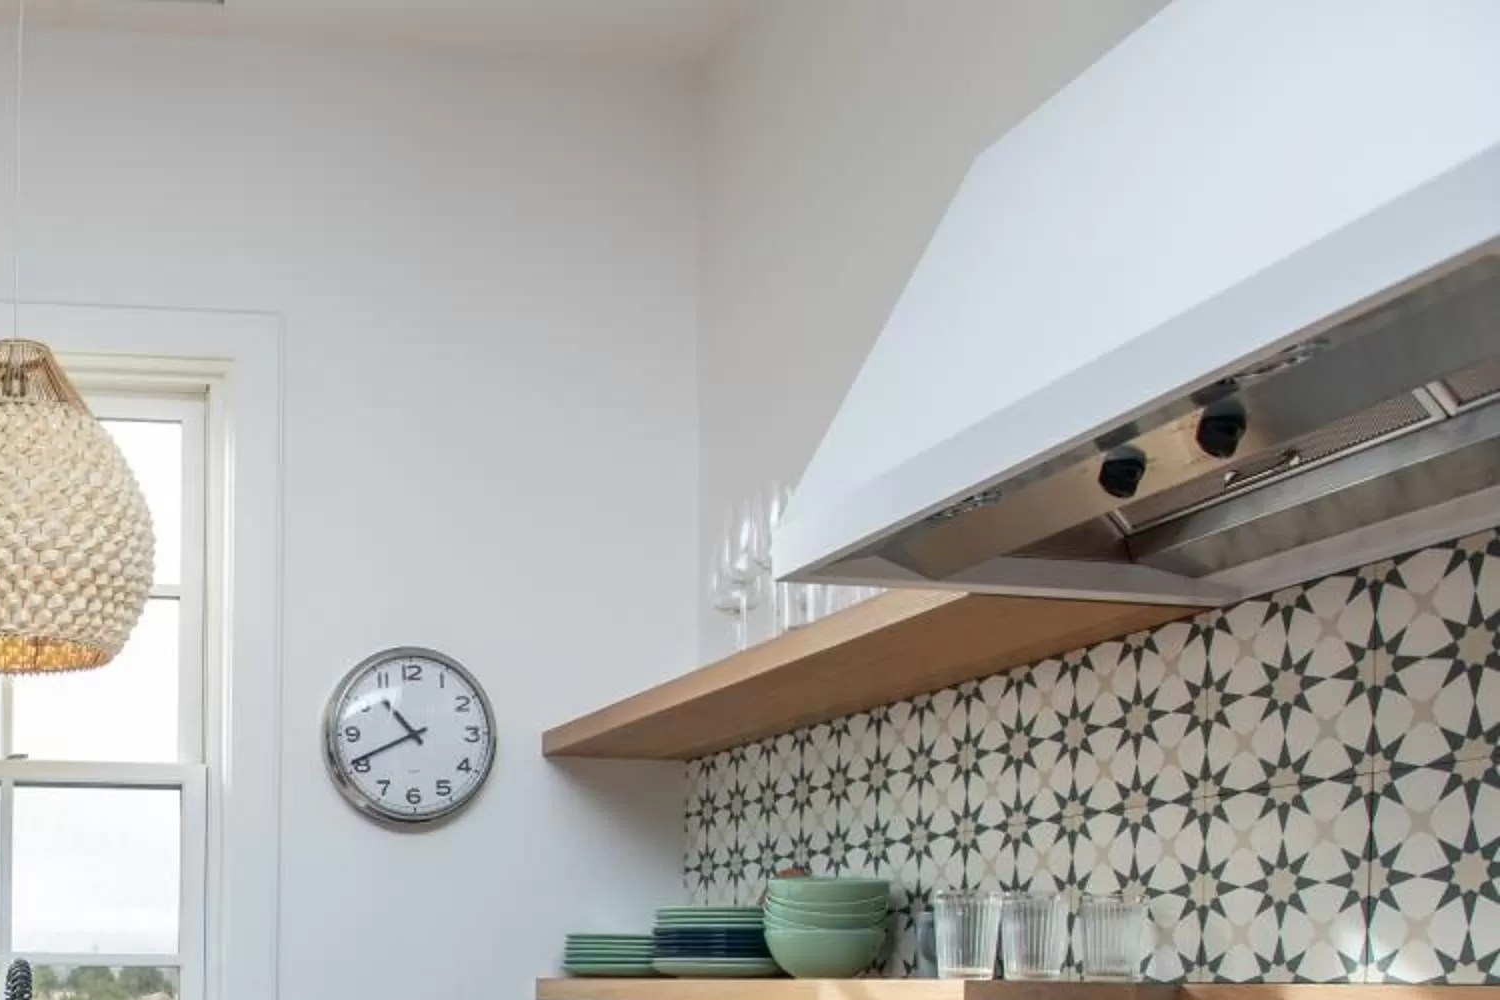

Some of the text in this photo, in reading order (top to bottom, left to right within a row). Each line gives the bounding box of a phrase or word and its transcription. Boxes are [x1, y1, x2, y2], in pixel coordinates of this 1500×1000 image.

[377, 672, 389, 688] 11
[402, 664, 423, 681] 12
[455, 695, 470, 712] 2
[345, 726, 361, 743] 9
[464, 726, 480, 743] 3
[353, 756, 371, 773] 8
[456, 757, 472, 774] 4
[376, 779, 391, 796] 7
[405, 787, 421, 804] 6
[435, 779, 451, 796] 5
